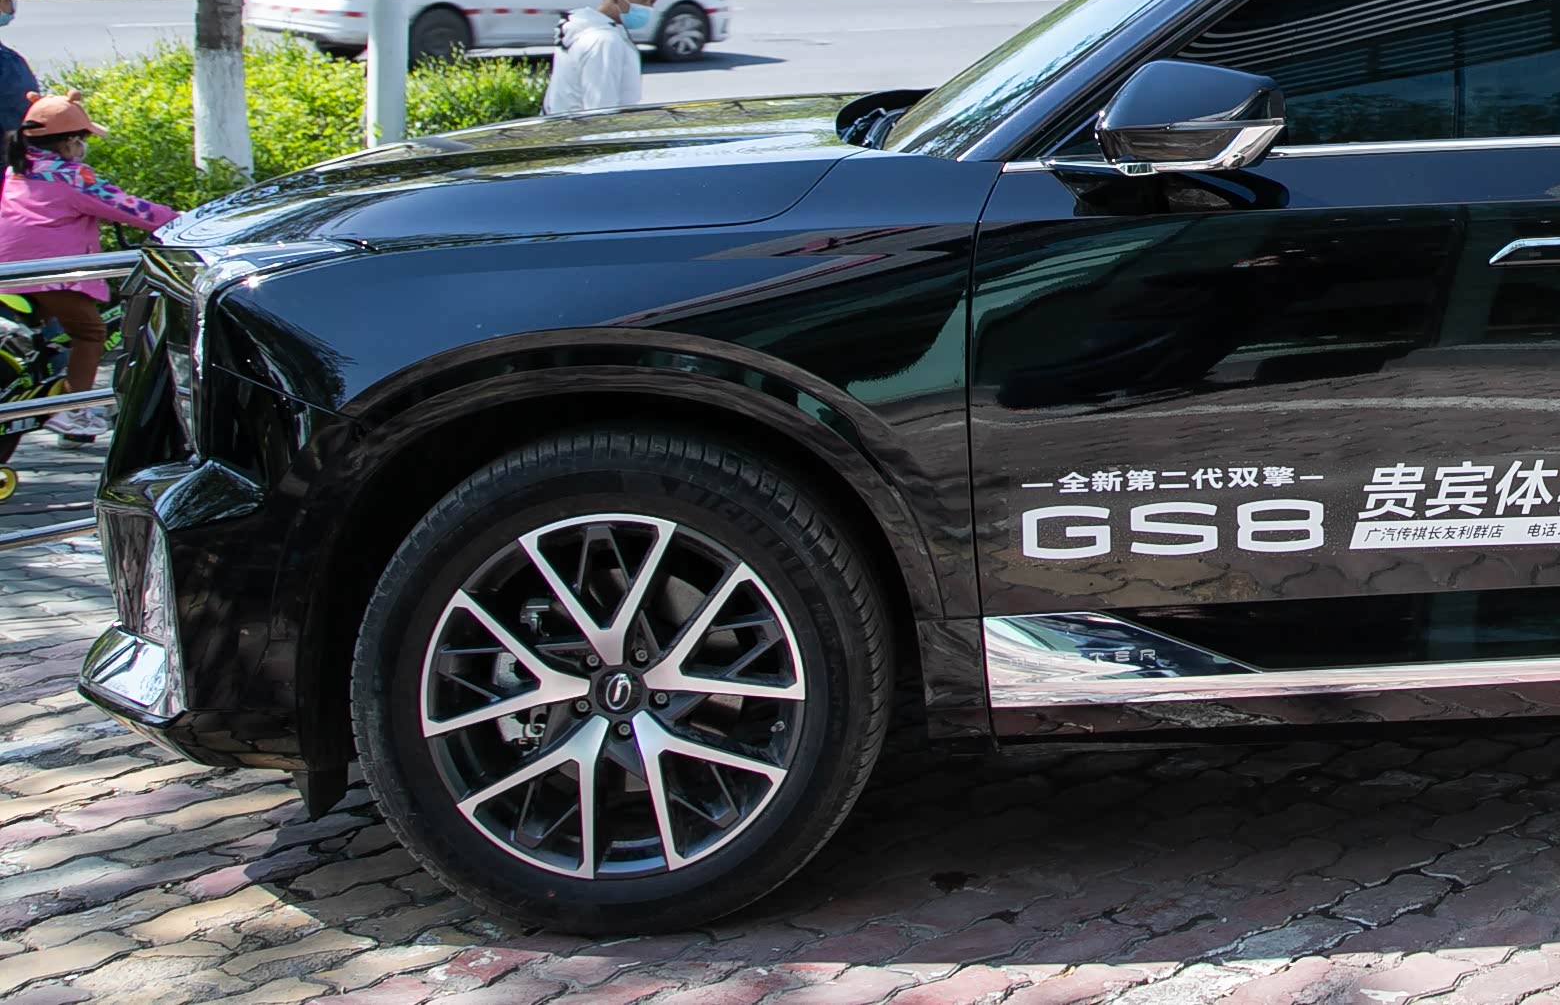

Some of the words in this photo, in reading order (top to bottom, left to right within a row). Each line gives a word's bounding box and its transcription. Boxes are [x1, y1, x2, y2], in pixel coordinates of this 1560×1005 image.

[1021, 498, 1325, 560] GS8
[1363, 523, 1506, 543] 广汽传祺长友利群店
